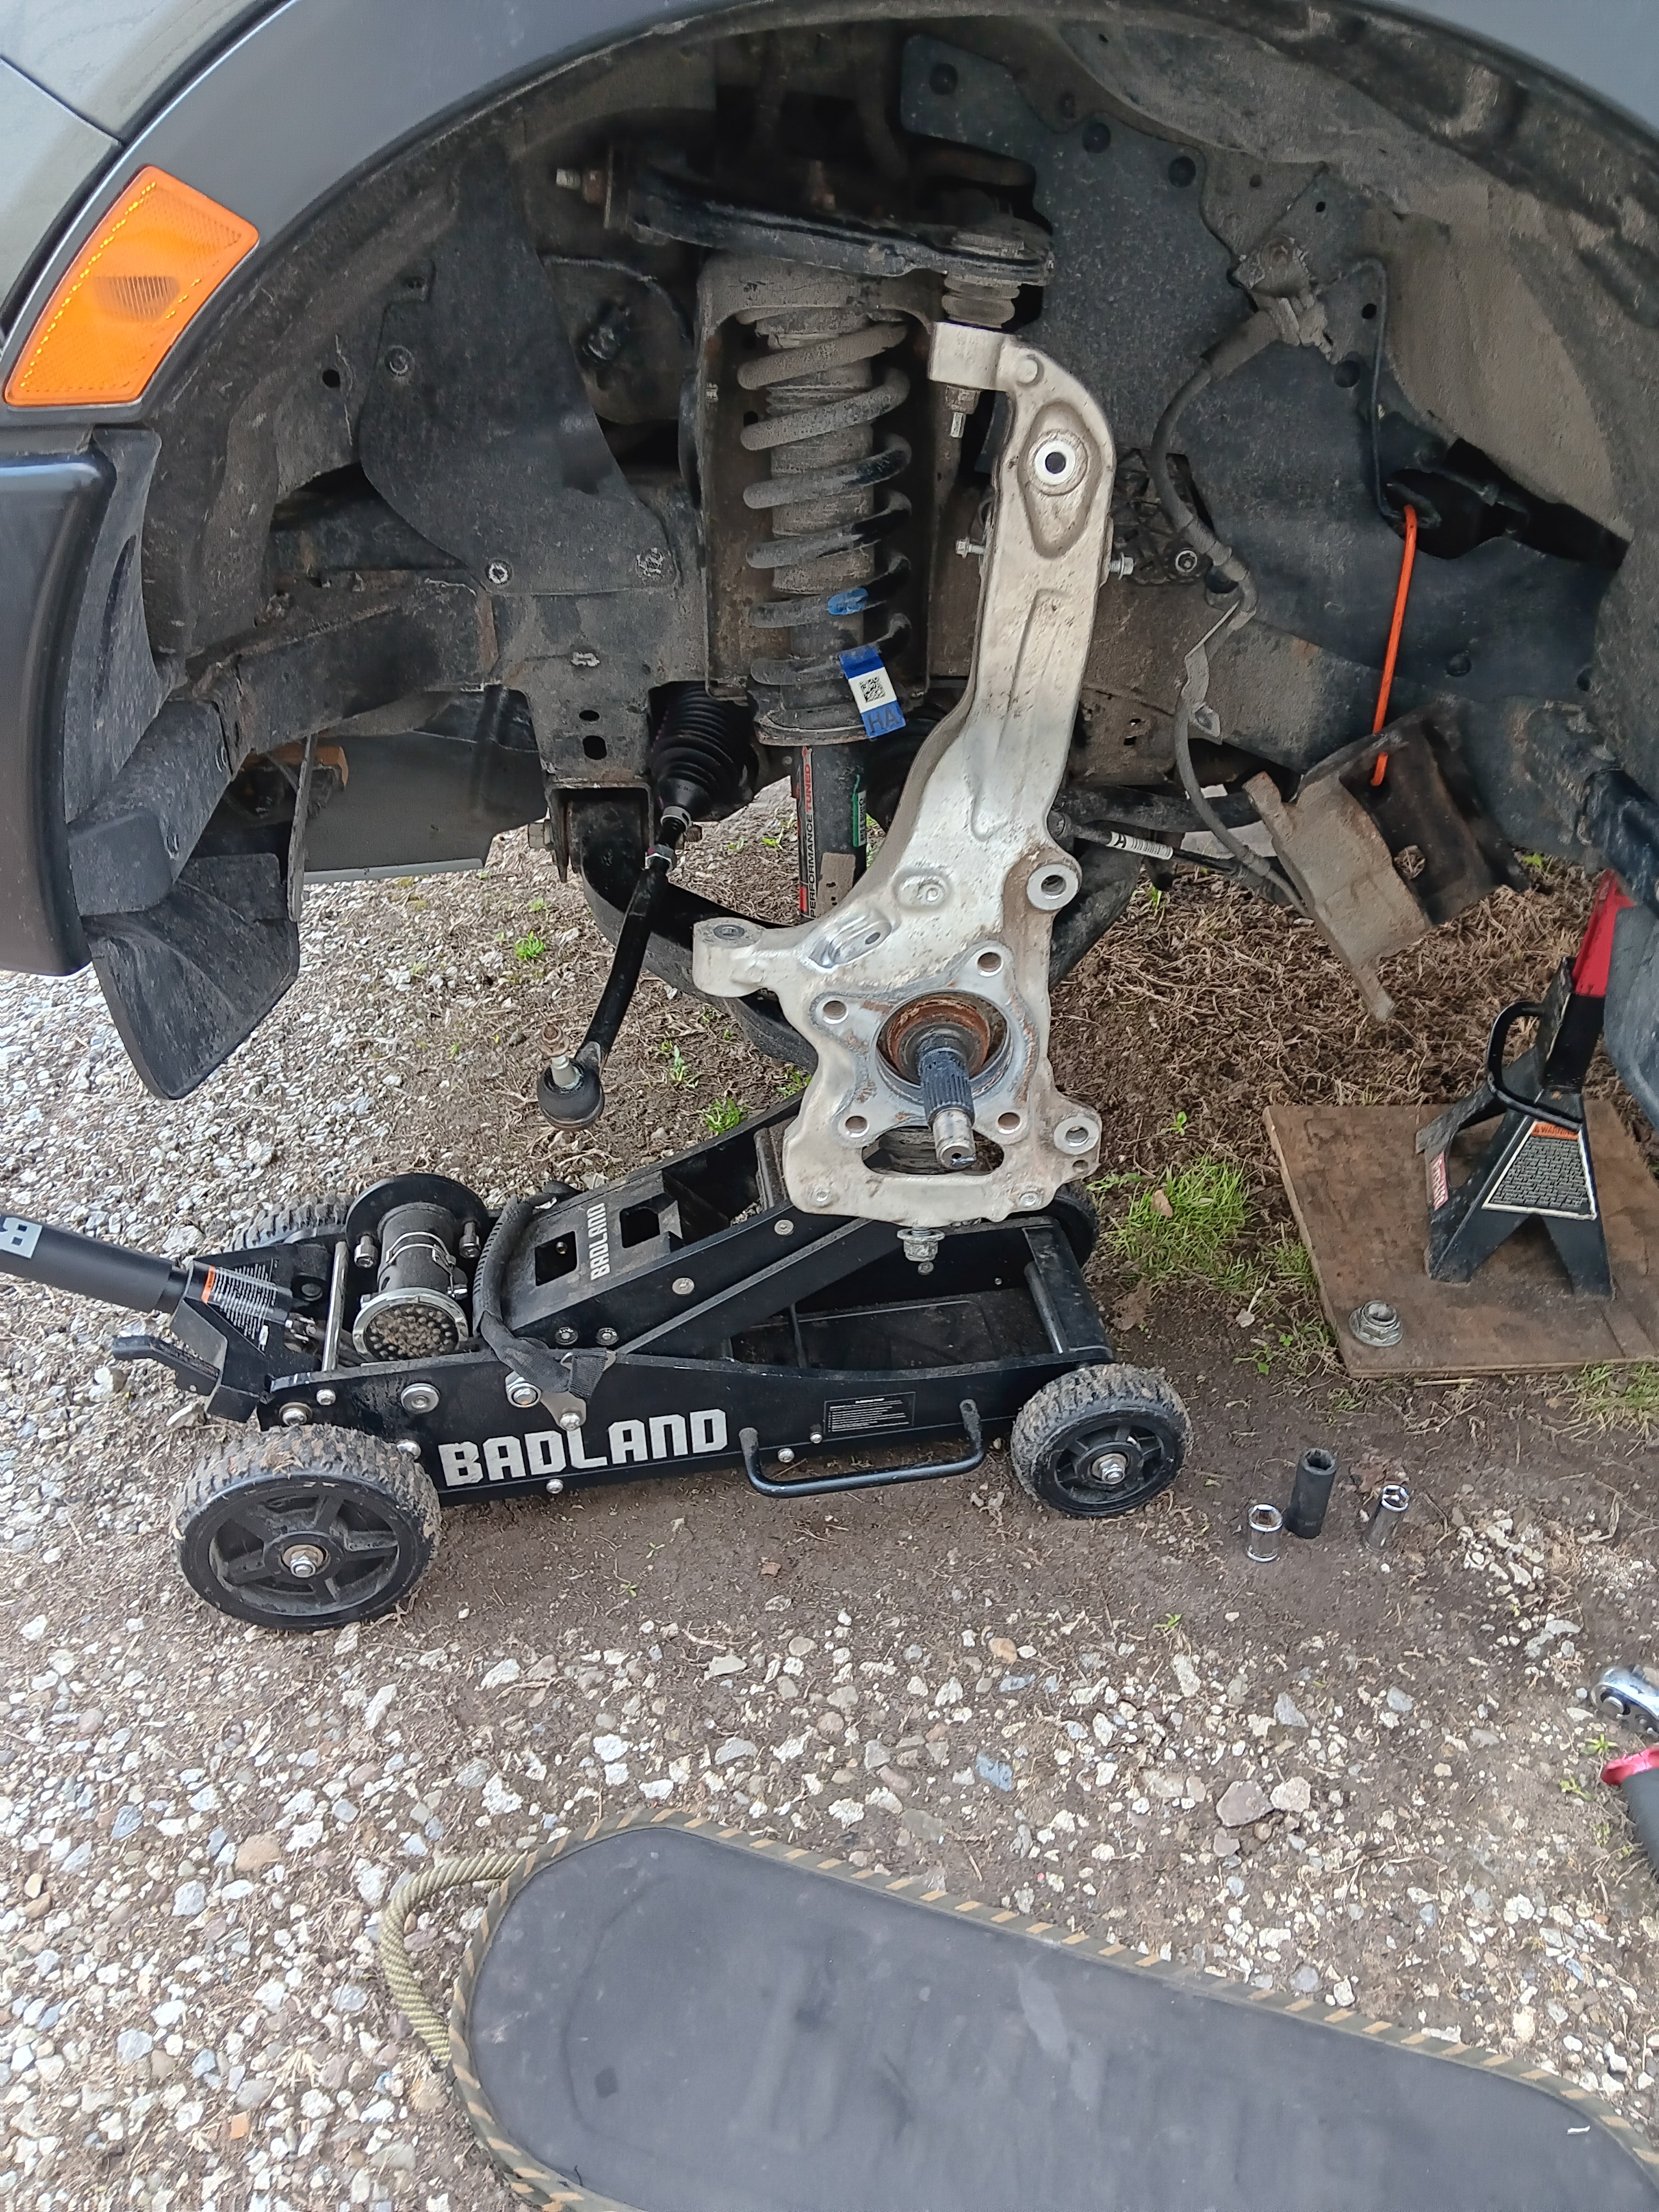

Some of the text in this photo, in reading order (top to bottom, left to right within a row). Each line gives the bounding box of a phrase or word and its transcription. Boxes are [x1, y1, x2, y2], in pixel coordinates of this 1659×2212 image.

[806, 814, 816, 918] PERFORMANCE
[587, 1203, 610, 1281] BADLAND
[438, 1409, 728, 1487] BADLAND
